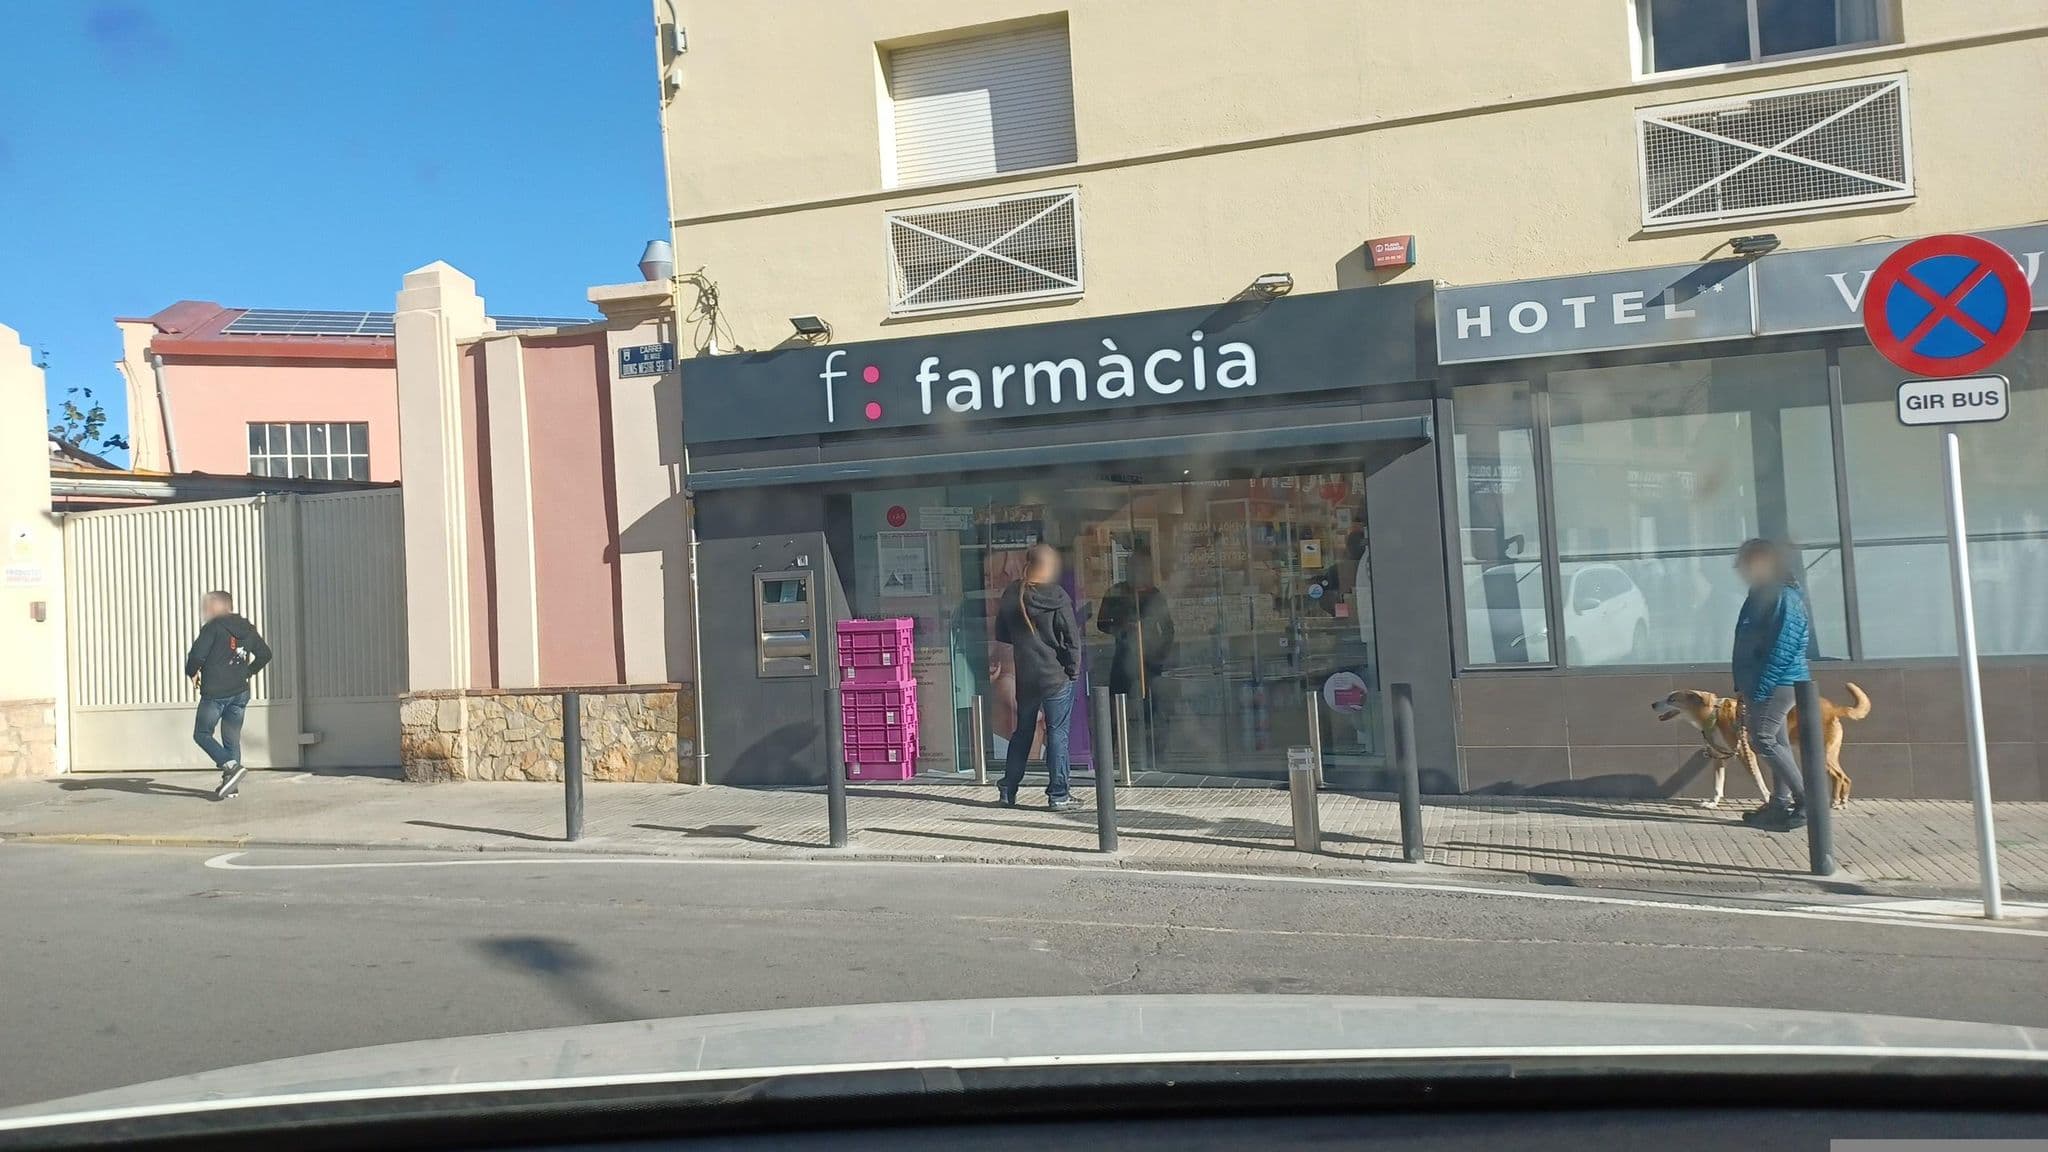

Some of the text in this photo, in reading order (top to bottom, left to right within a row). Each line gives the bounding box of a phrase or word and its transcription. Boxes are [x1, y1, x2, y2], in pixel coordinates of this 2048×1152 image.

[1456, 287, 1696, 339] HOTEL
[915, 330, 1257, 415] farmàcia
[1905, 390, 1999, 411] GIR BUS
